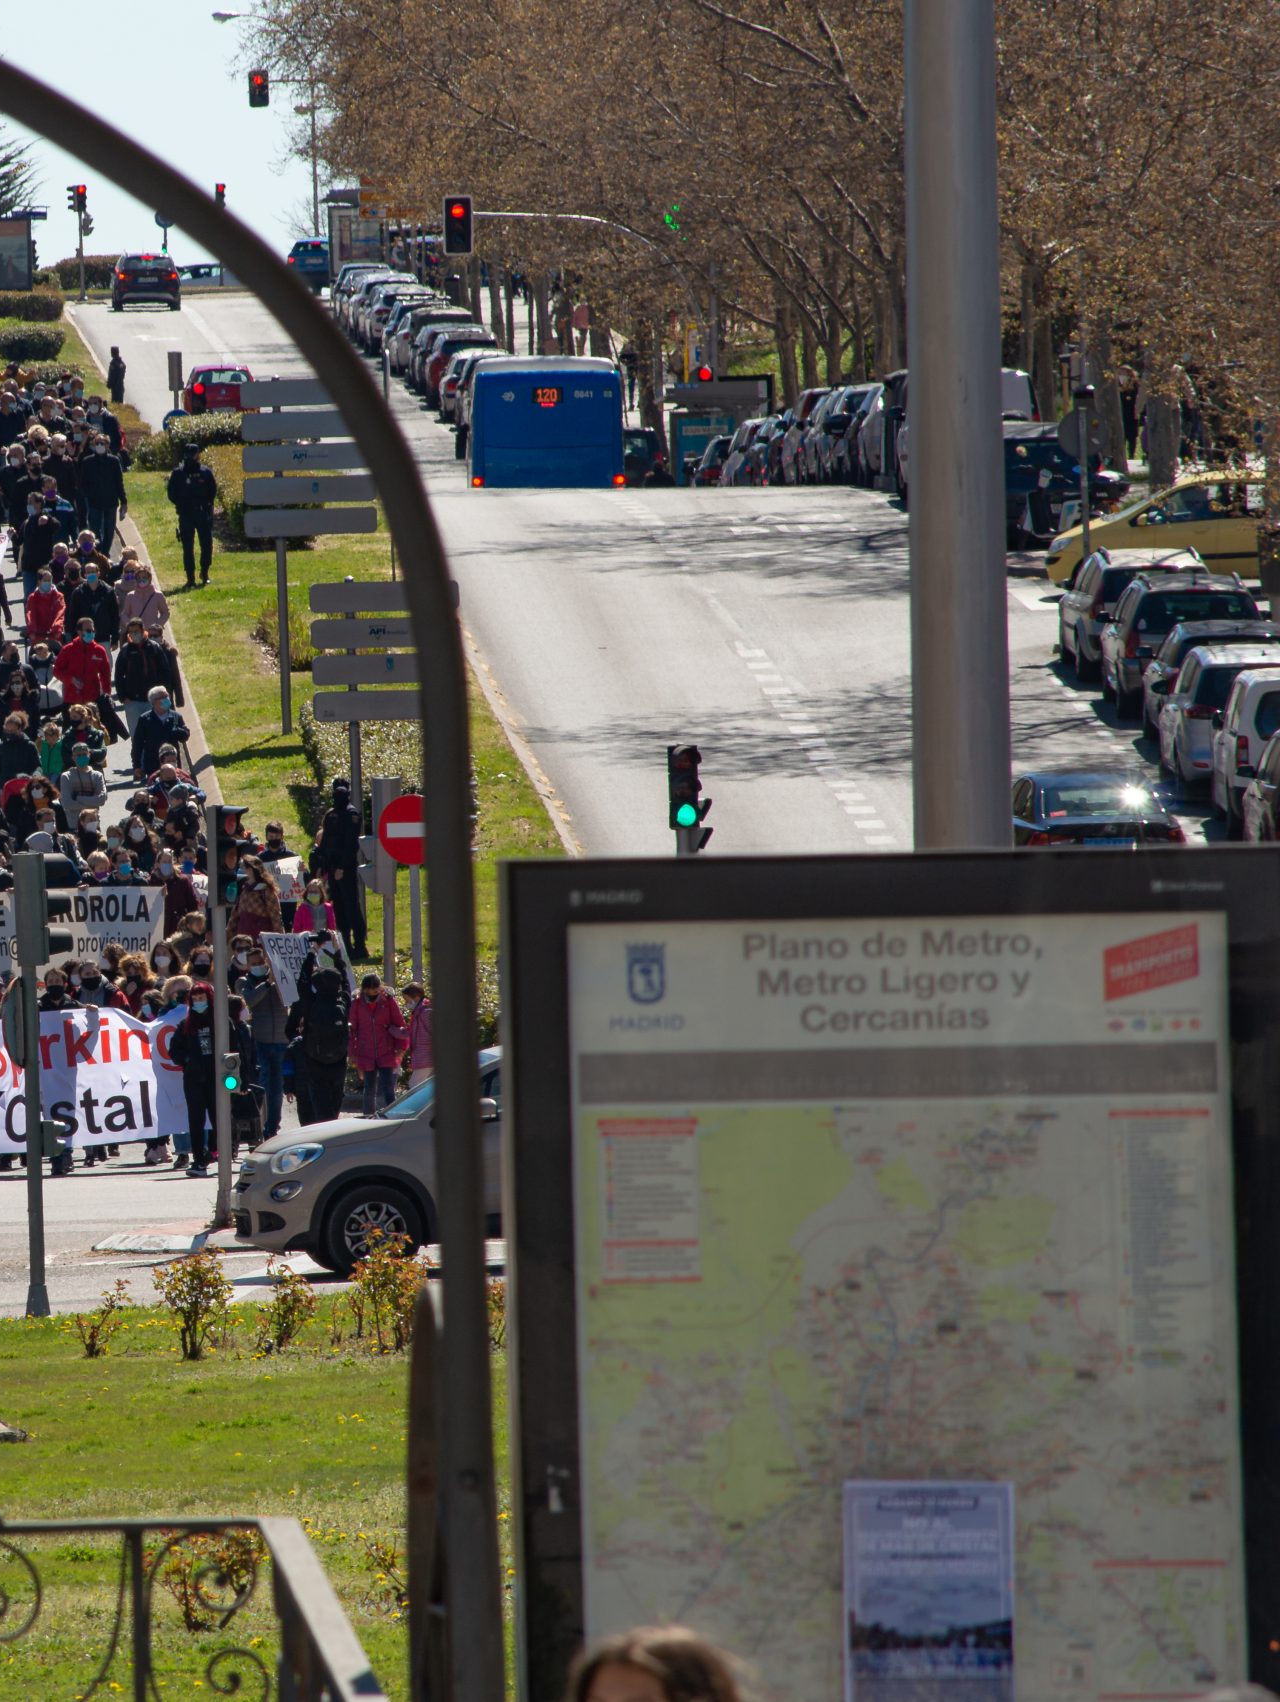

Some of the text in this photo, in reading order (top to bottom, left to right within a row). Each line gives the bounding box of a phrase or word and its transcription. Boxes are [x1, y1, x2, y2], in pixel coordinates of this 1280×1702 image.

[536, 388, 557, 402] 120
[77, 932, 152, 957] provisional
[742, 929, 1043, 961] Plano de Metro,
[757, 964, 1031, 1001] Metro Ligero y
[609, 1014, 686, 1032] MADRID
[799, 1002, 990, 1033] Cercanías
